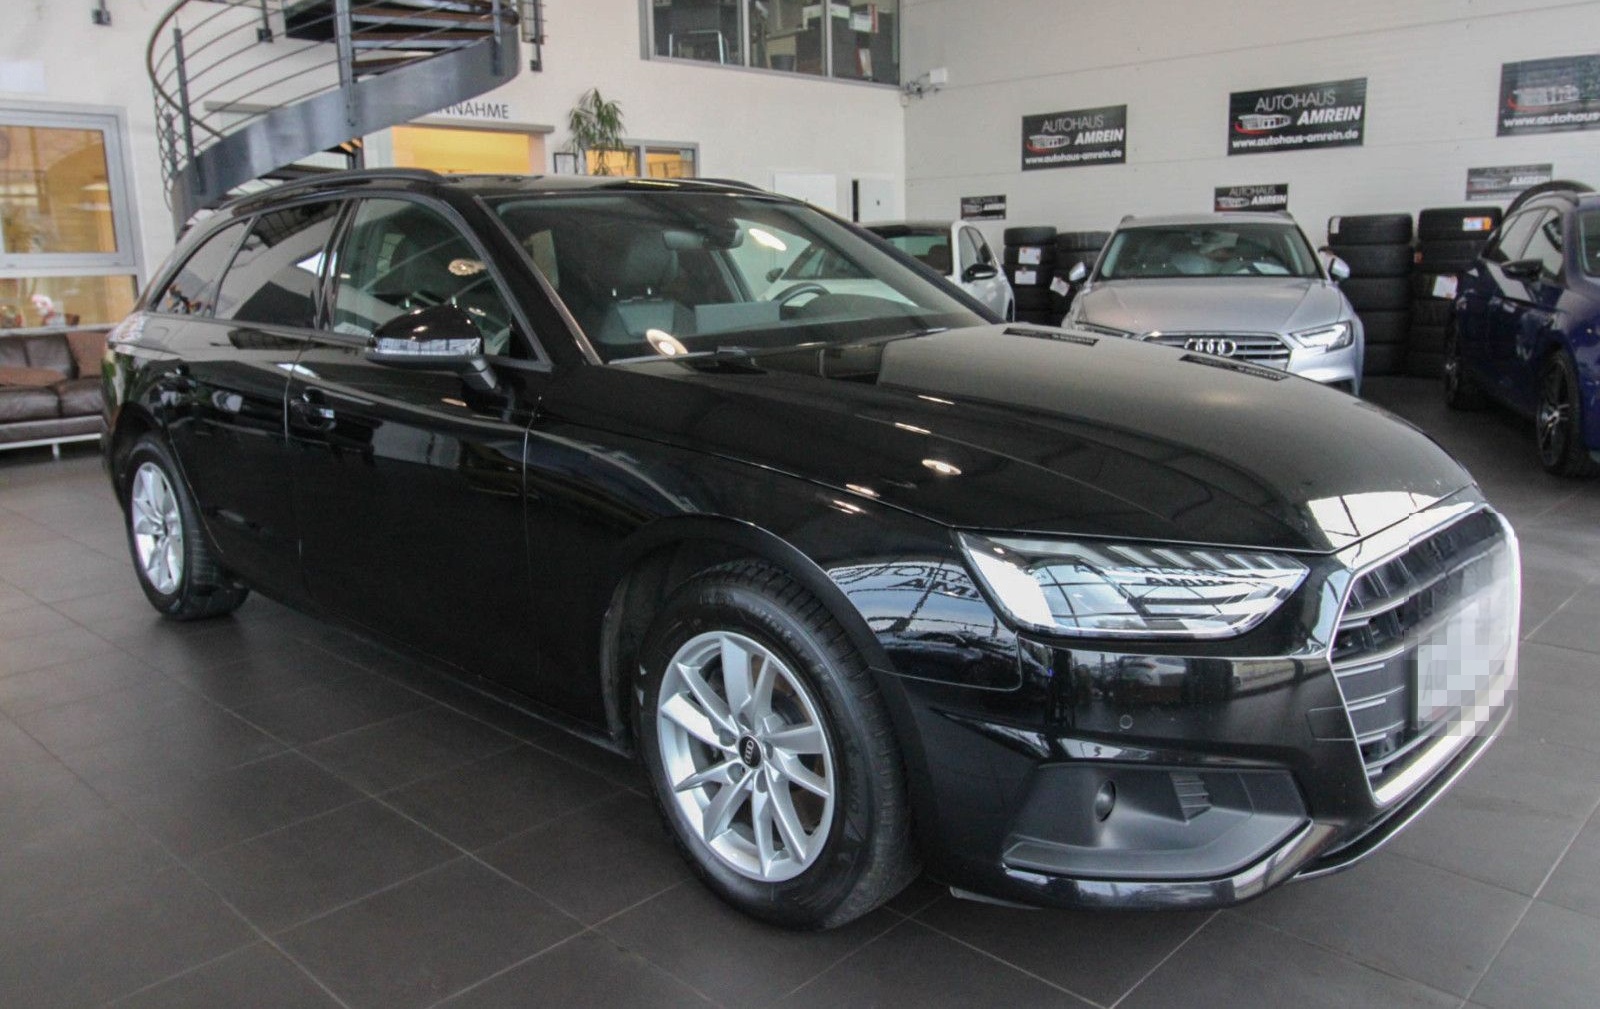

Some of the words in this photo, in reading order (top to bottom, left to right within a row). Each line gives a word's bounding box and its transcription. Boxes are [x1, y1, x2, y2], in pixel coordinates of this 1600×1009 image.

[1255, 89, 1336, 112] AUTOHAUS
[1041, 114, 1105, 133] AUTOHAUS
[1297, 105, 1362, 126] AMREIN
[1074, 128, 1124, 146] AMREIN
[1232, 129, 1359, 149] www.autohaus-amrein.de
[1024, 150, 1122, 164] www.autohaus-amrein.de
